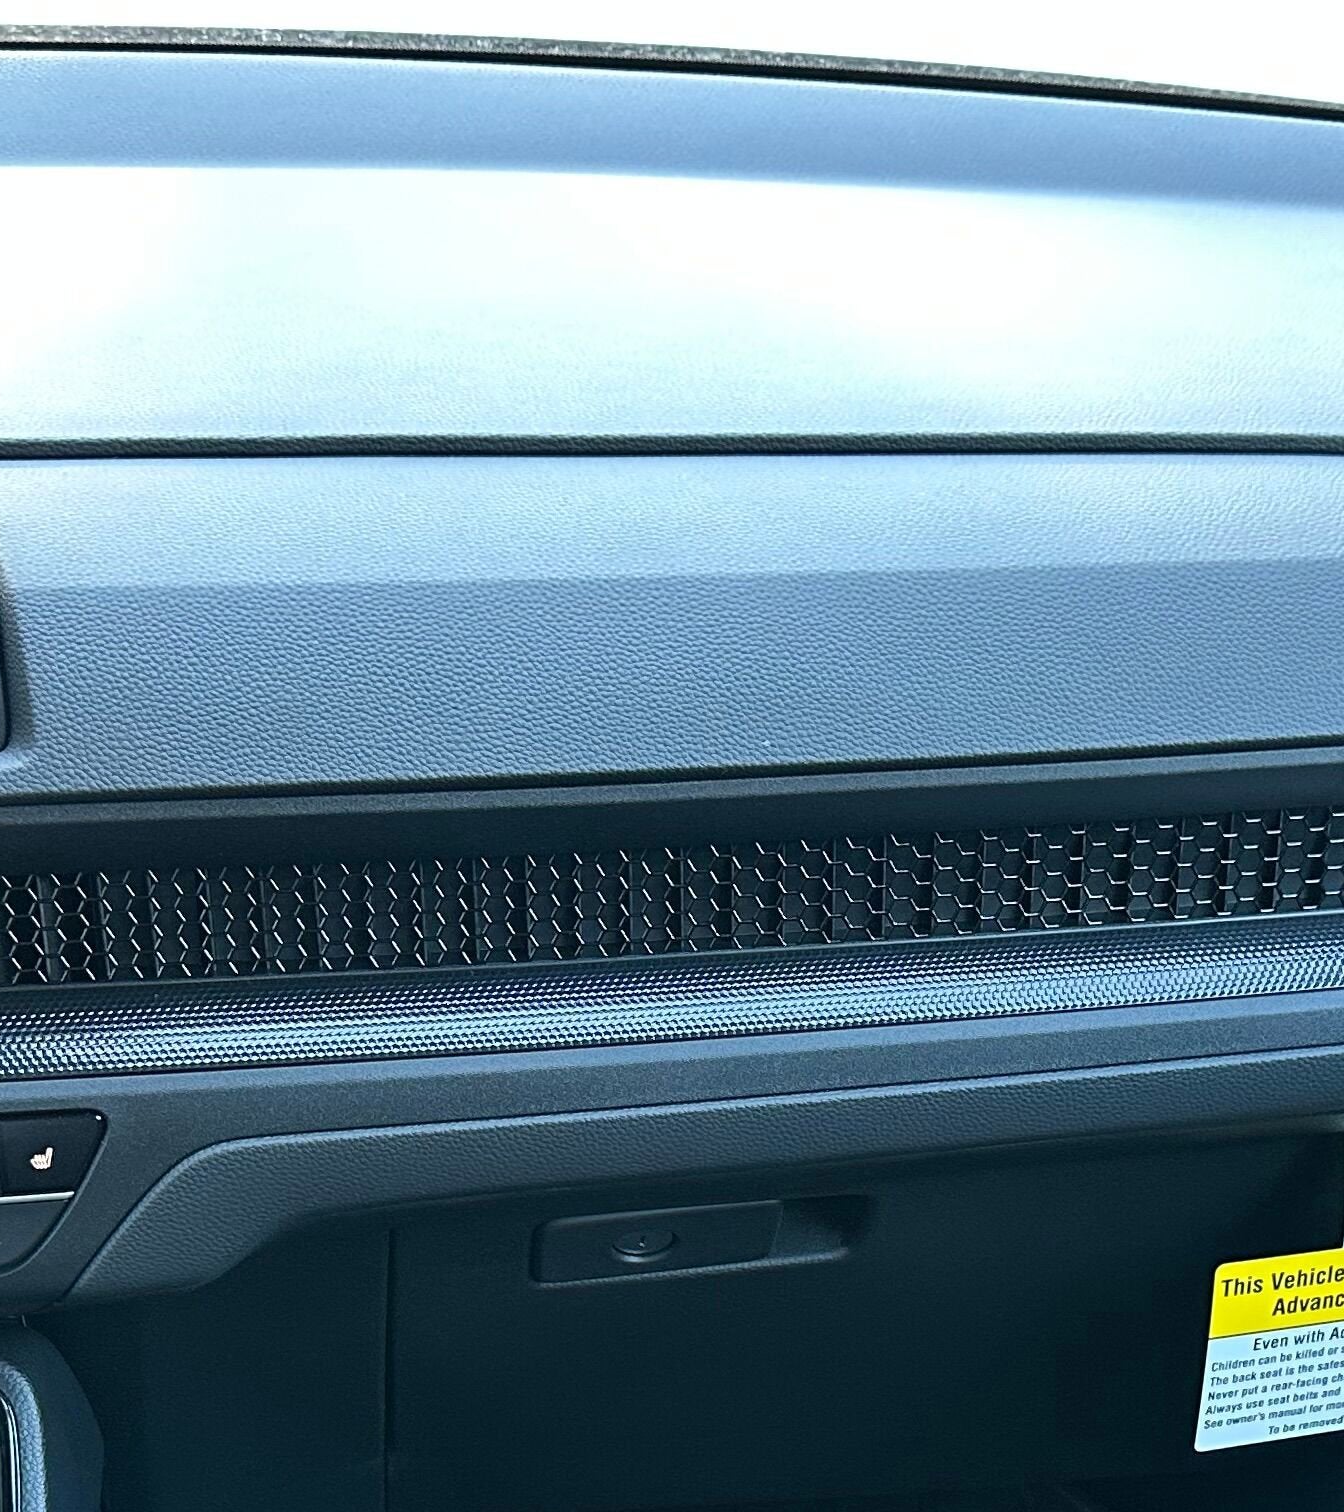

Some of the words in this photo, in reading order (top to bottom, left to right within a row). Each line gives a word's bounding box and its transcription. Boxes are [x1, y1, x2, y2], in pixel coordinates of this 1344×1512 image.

[1221, 1276, 1264, 1297] This
[1253, 1335, 1289, 1351] Even
[1294, 1329, 1325, 1344] with
[1211, 1358, 1256, 1372] Children
[1258, 1355, 1277, 1366] can
[1280, 1352, 1293, 1362] be
[1295, 1347, 1325, 1360] killed
[1327, 1347, 1339, 1355] or
[1210, 1376, 1229, 1387] The
[1232, 1371, 1257, 1384] back
[1260, 1368, 1283, 1380] seat
[1285, 1366, 1295, 1376] is
[1298, 1363, 1315, 1374] the
[1208, 1389, 1239, 1401] Never
[1241, 1385, 1258, 1398] put
[1271, 1376, 1329, 1392] rear-facing
[1205, 1401, 1243, 1415] Always
[1246, 1399, 1265, 1410] use
[1268, 1395, 1290, 1406] seat
[1293, 1390, 1319, 1403] belts
[1321, 1387, 1341, 1398] and
[1204, 1419, 1223, 1430] See
[1226, 1413, 1265, 1426] owner's
[1268, 1405, 1307, 1419] manual
[1309, 1401, 1323, 1412] for
[1268, 1425, 1280, 1435] To
[1282, 1423, 1296, 1433] be
[1298, 1415, 1343, 1430] removed
